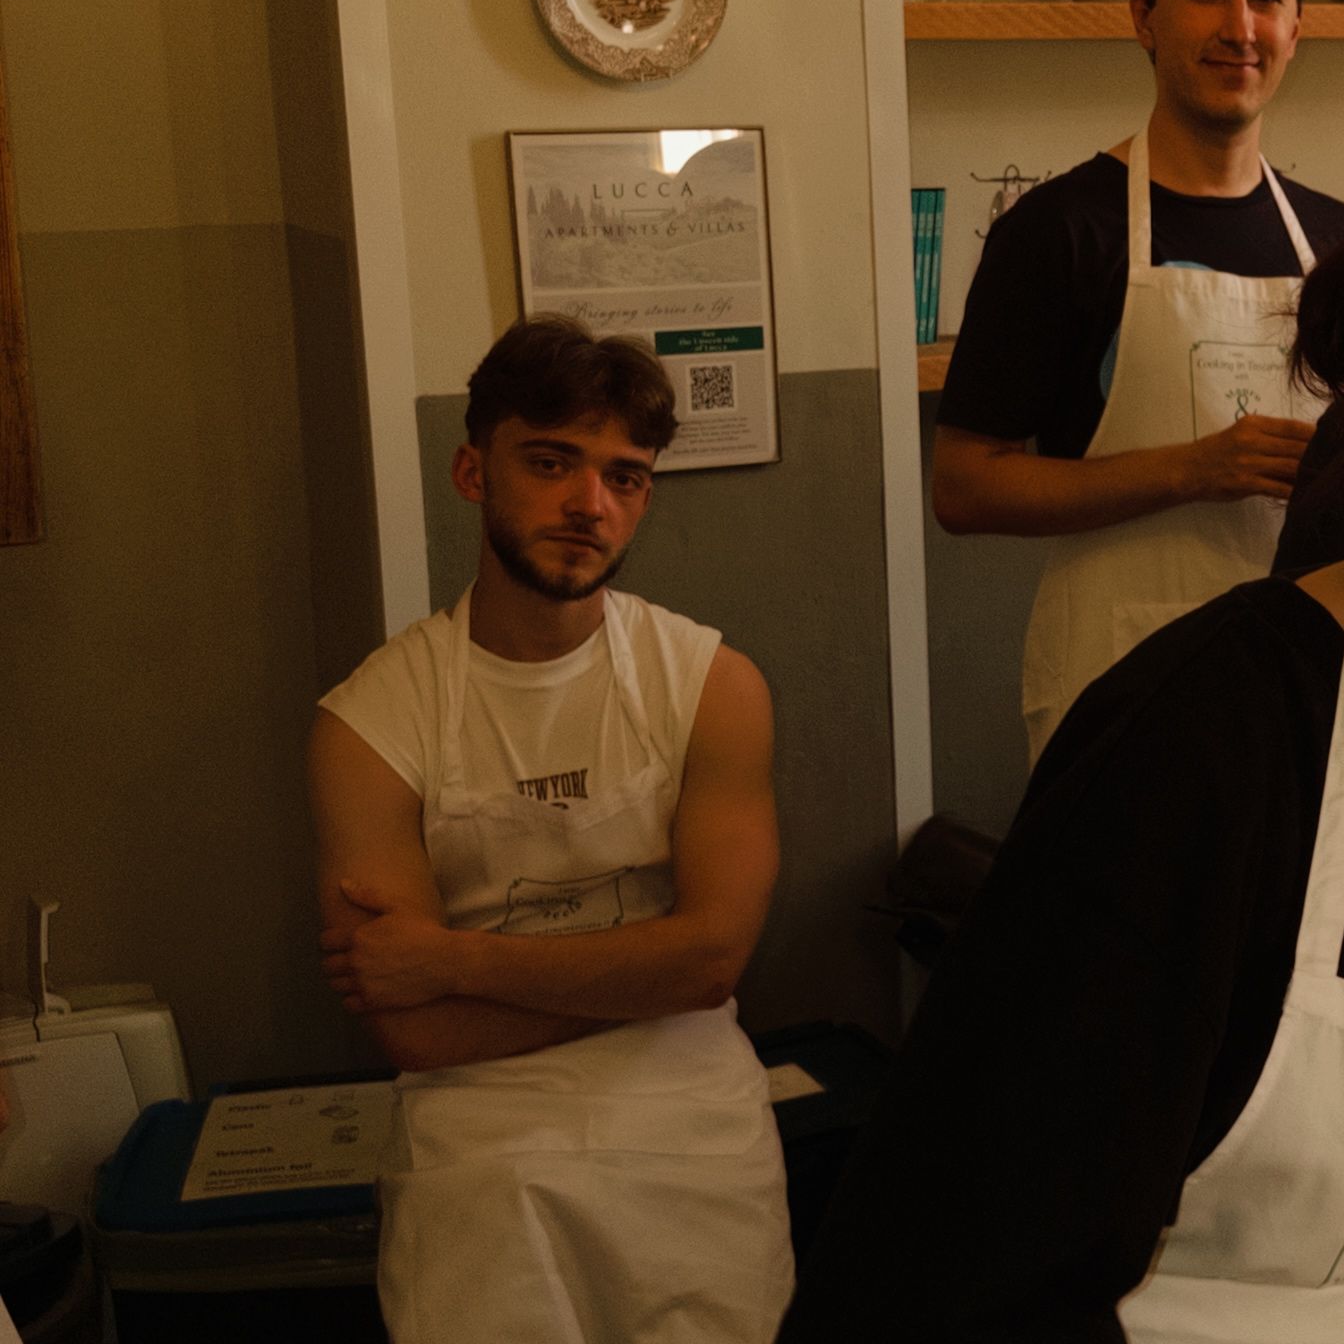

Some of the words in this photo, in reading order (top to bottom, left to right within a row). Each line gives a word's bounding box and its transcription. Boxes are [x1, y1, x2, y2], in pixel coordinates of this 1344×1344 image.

[592, 180, 694, 200] LUCCA
[545, 222, 659, 240] APARTMENTS
[666, 220, 680, 237] &
[688, 221, 746, 235] VILLAS
[565, 301, 639, 326] Bringing
[693, 302, 706, 312] to
[710, 296, 734, 320] life
[549, 768, 588, 800] YORK
